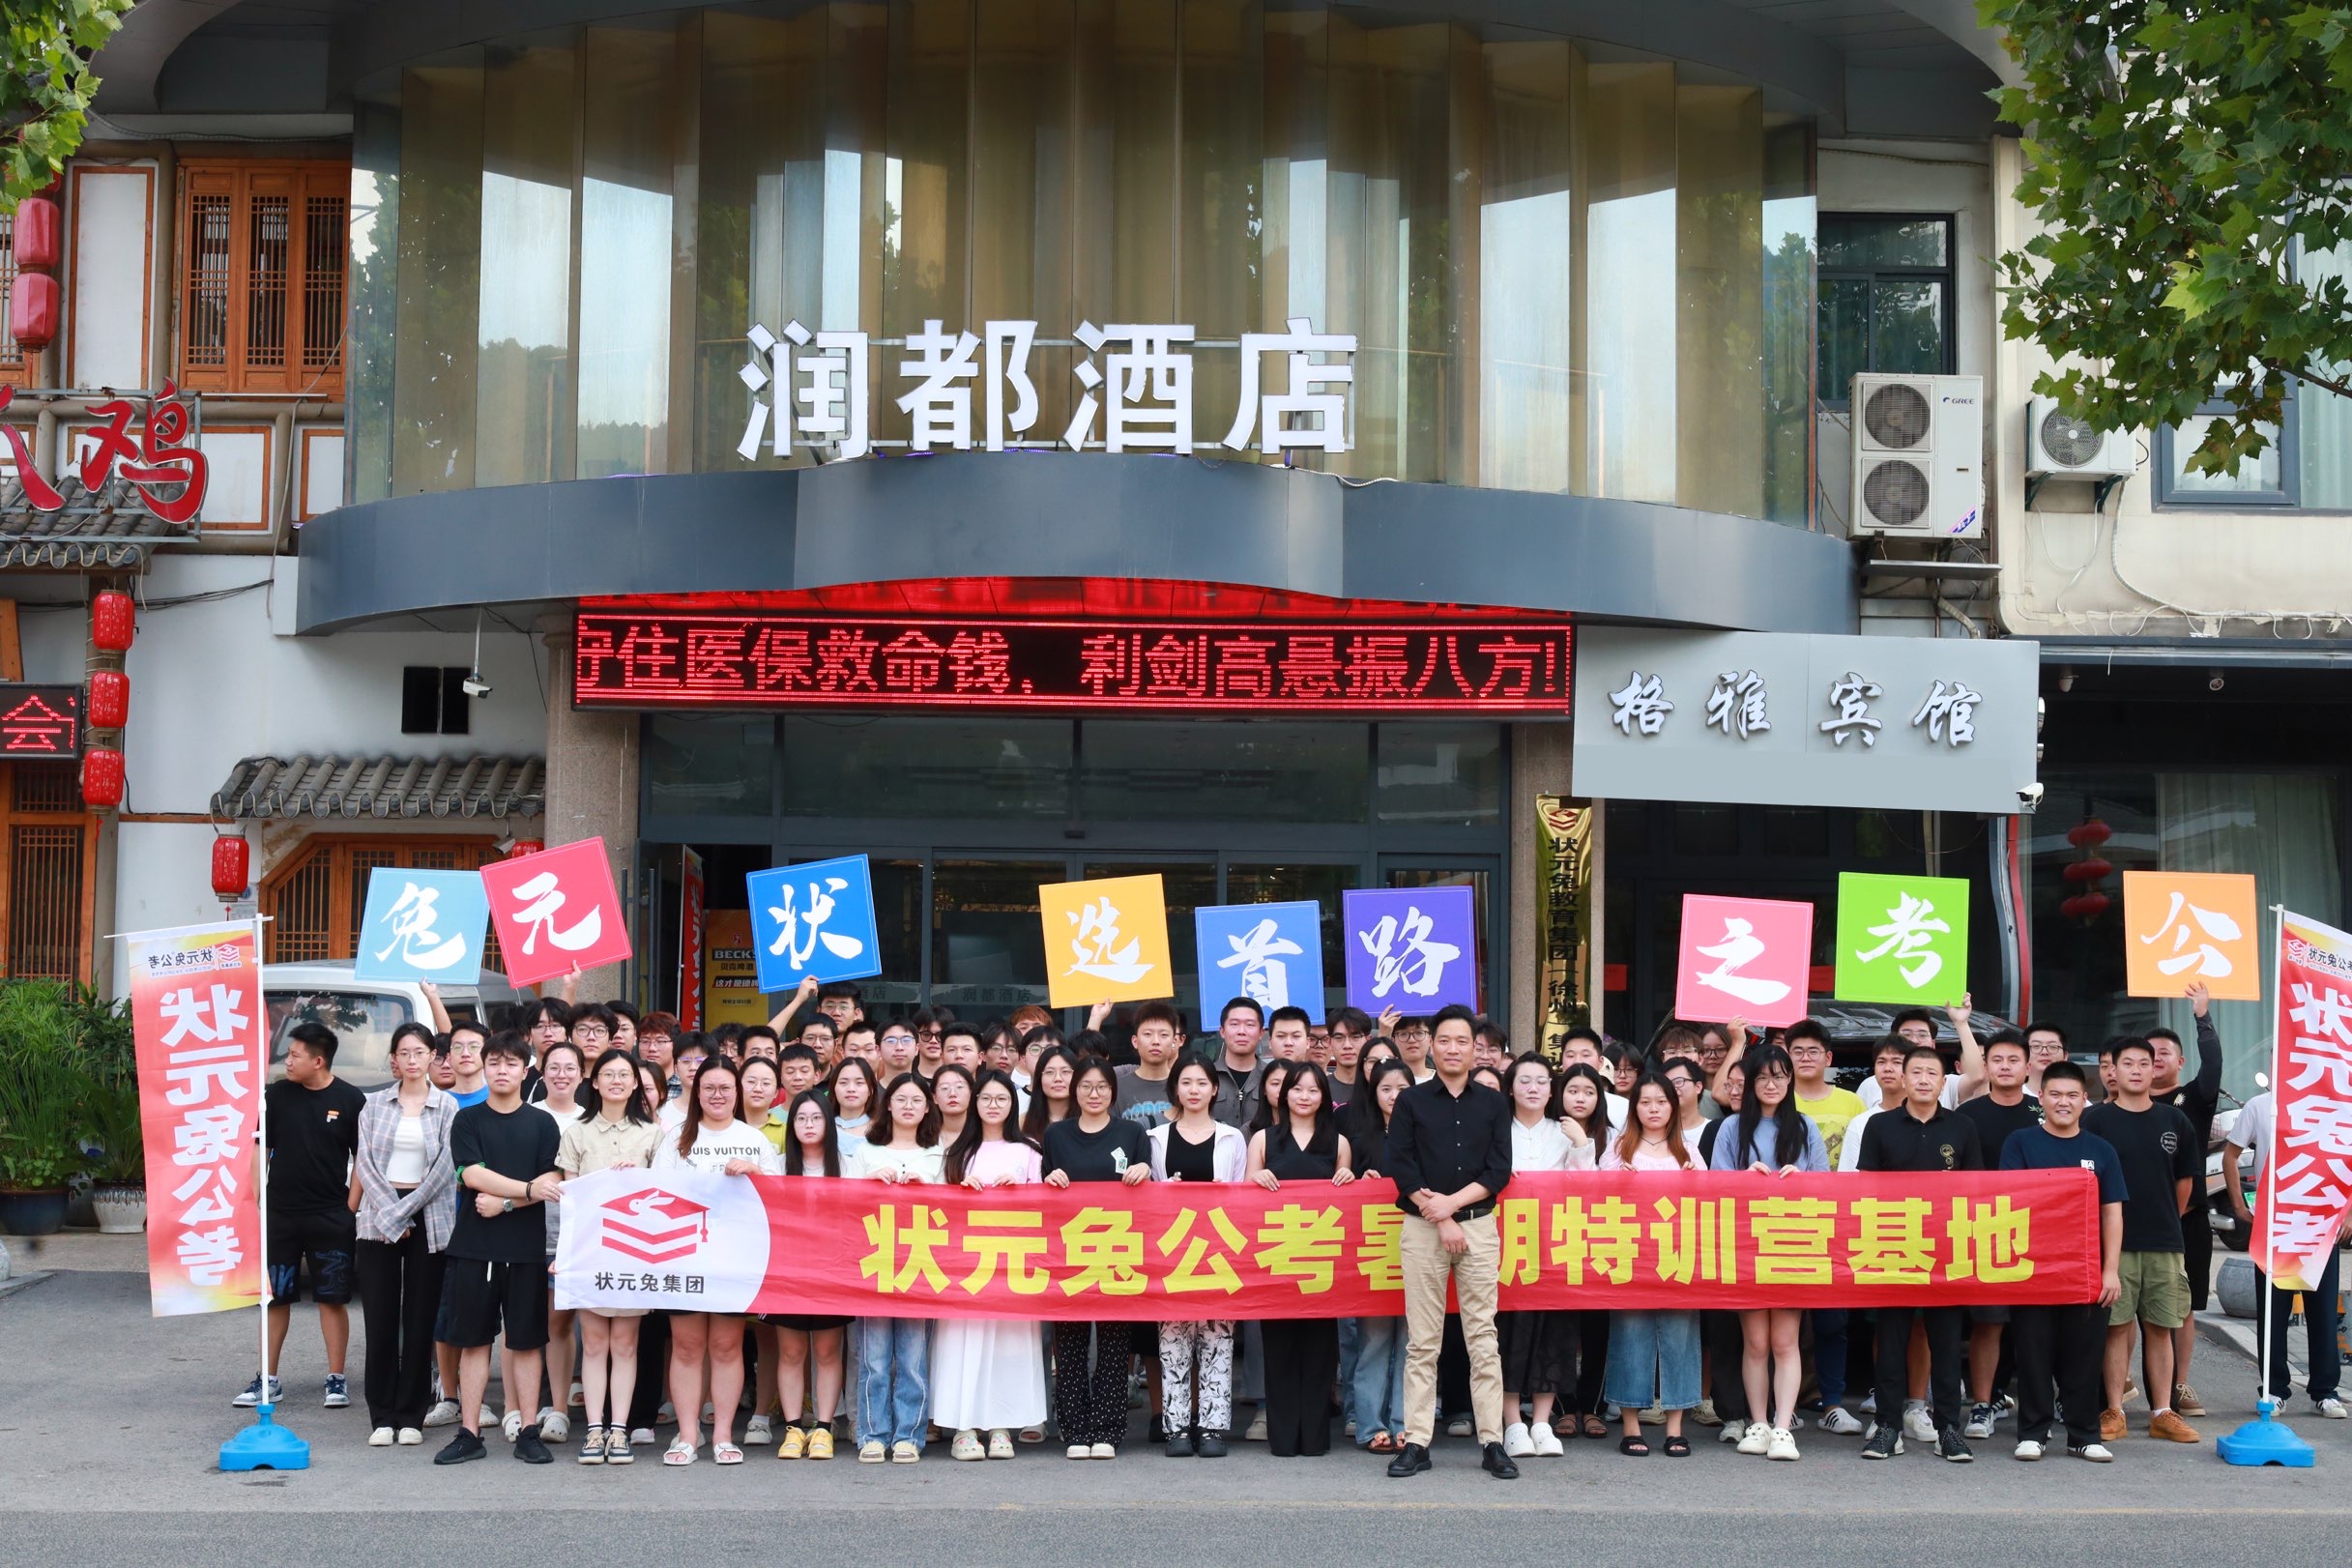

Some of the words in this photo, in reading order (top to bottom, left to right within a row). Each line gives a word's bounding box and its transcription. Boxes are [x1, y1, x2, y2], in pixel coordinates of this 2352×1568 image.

[737, 317, 1357, 461] 润都酒店
[1608, 669, 1984, 748] 格雅宾馆
[374, 882, 467, 971] 兔
[511, 871, 601, 954] 元
[768, 877, 863, 971] 状
[1063, 896, 1155, 984] 选
[1358, 906, 1461, 998] 路
[1856, 890, 1951, 990] 考
[2140, 891, 2243, 978] 公
[1217, 918, 1304, 1010] 首
[1696, 916, 1792, 1006] 之
[714, 1147, 760, 1156] VUITTON
[595, 1271, 704, 1293] 状元兔集团
